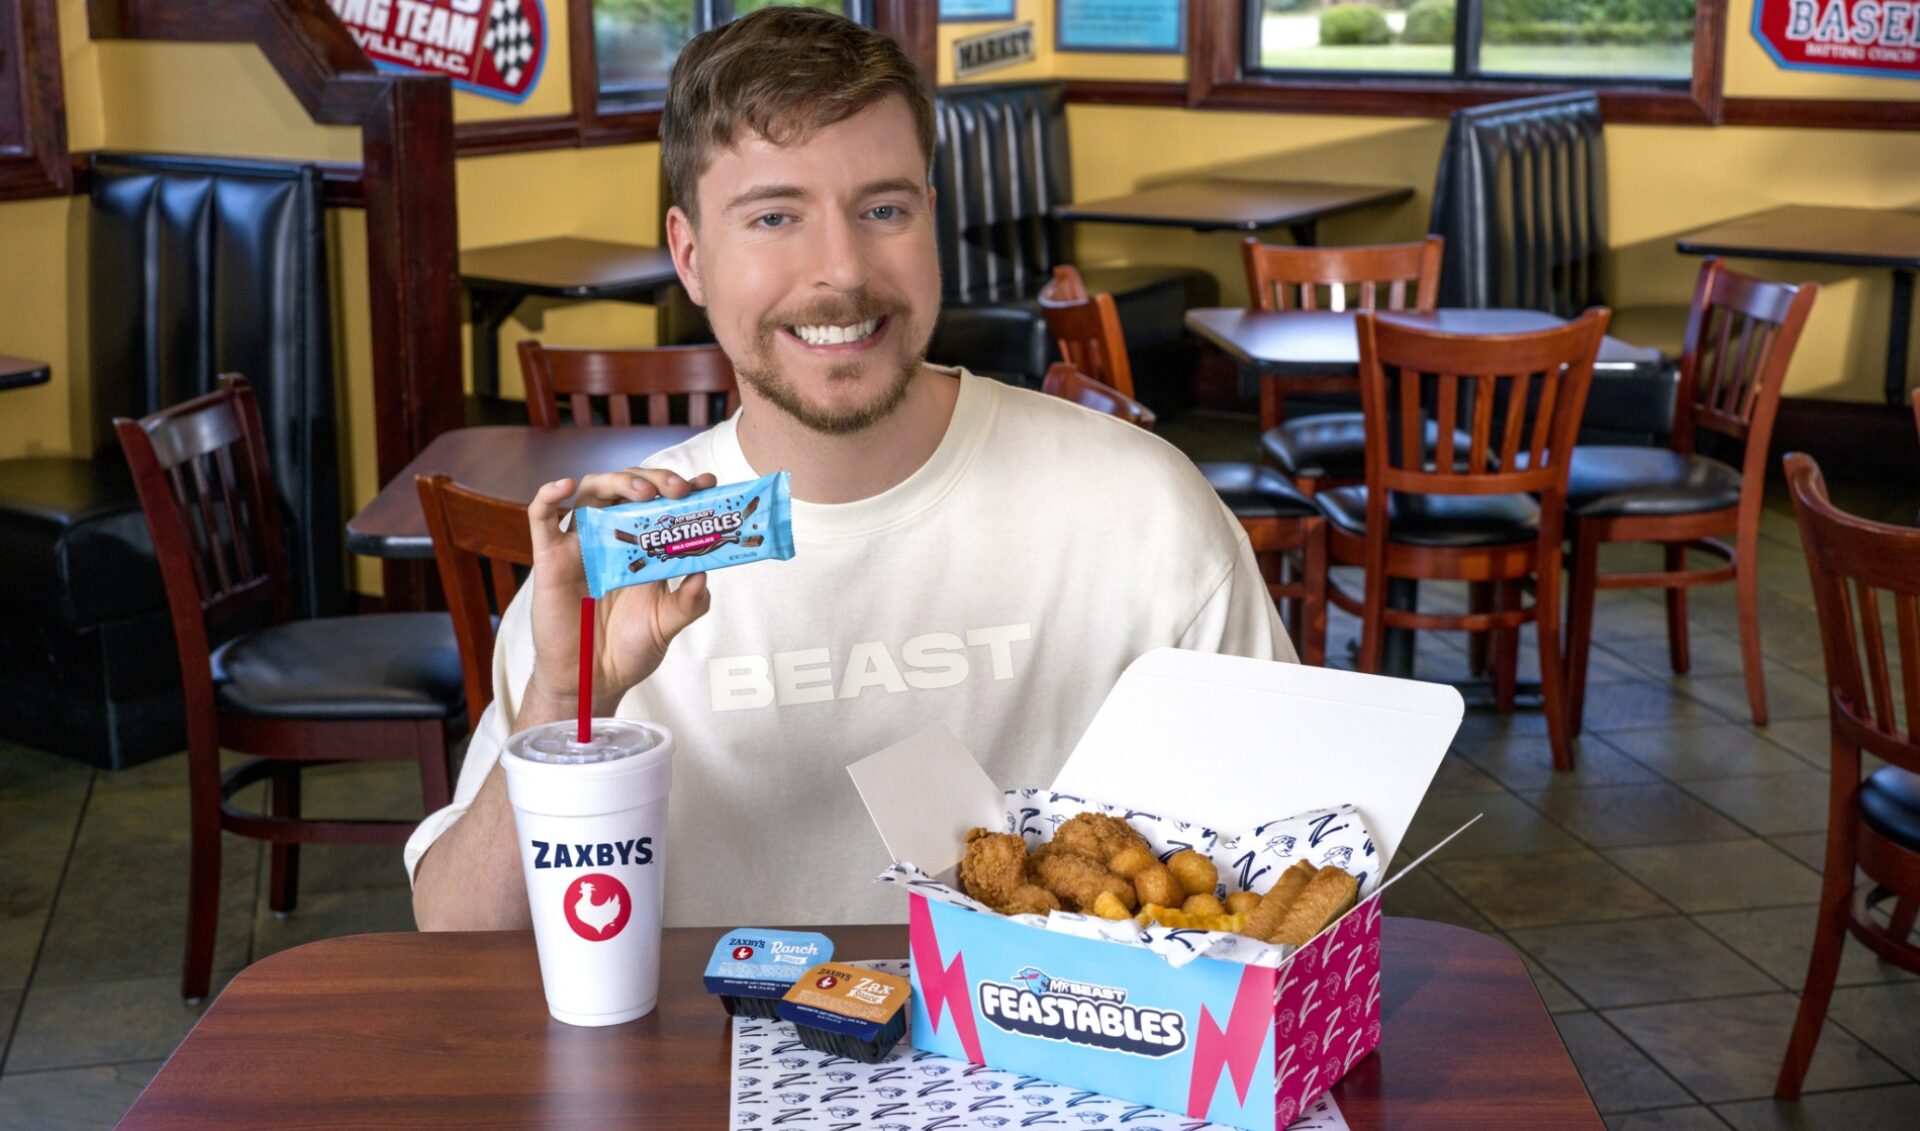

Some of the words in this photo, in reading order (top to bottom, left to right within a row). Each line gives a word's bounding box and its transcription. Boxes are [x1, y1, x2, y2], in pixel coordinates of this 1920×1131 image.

[394, 0, 479, 55] TEAM
[423, 47, 470, 75] N.C.
[958, 30, 1031, 71] MARKET
[640, 512, 743, 549] FEASTABLES
[708, 622, 1032, 712] BEAST
[531, 836, 653, 869] ZAXBYS
[770, 941, 819, 956] Ranch
[854, 977, 896, 996] Zax
[980, 982, 1187, 1053] FEASTABLES
